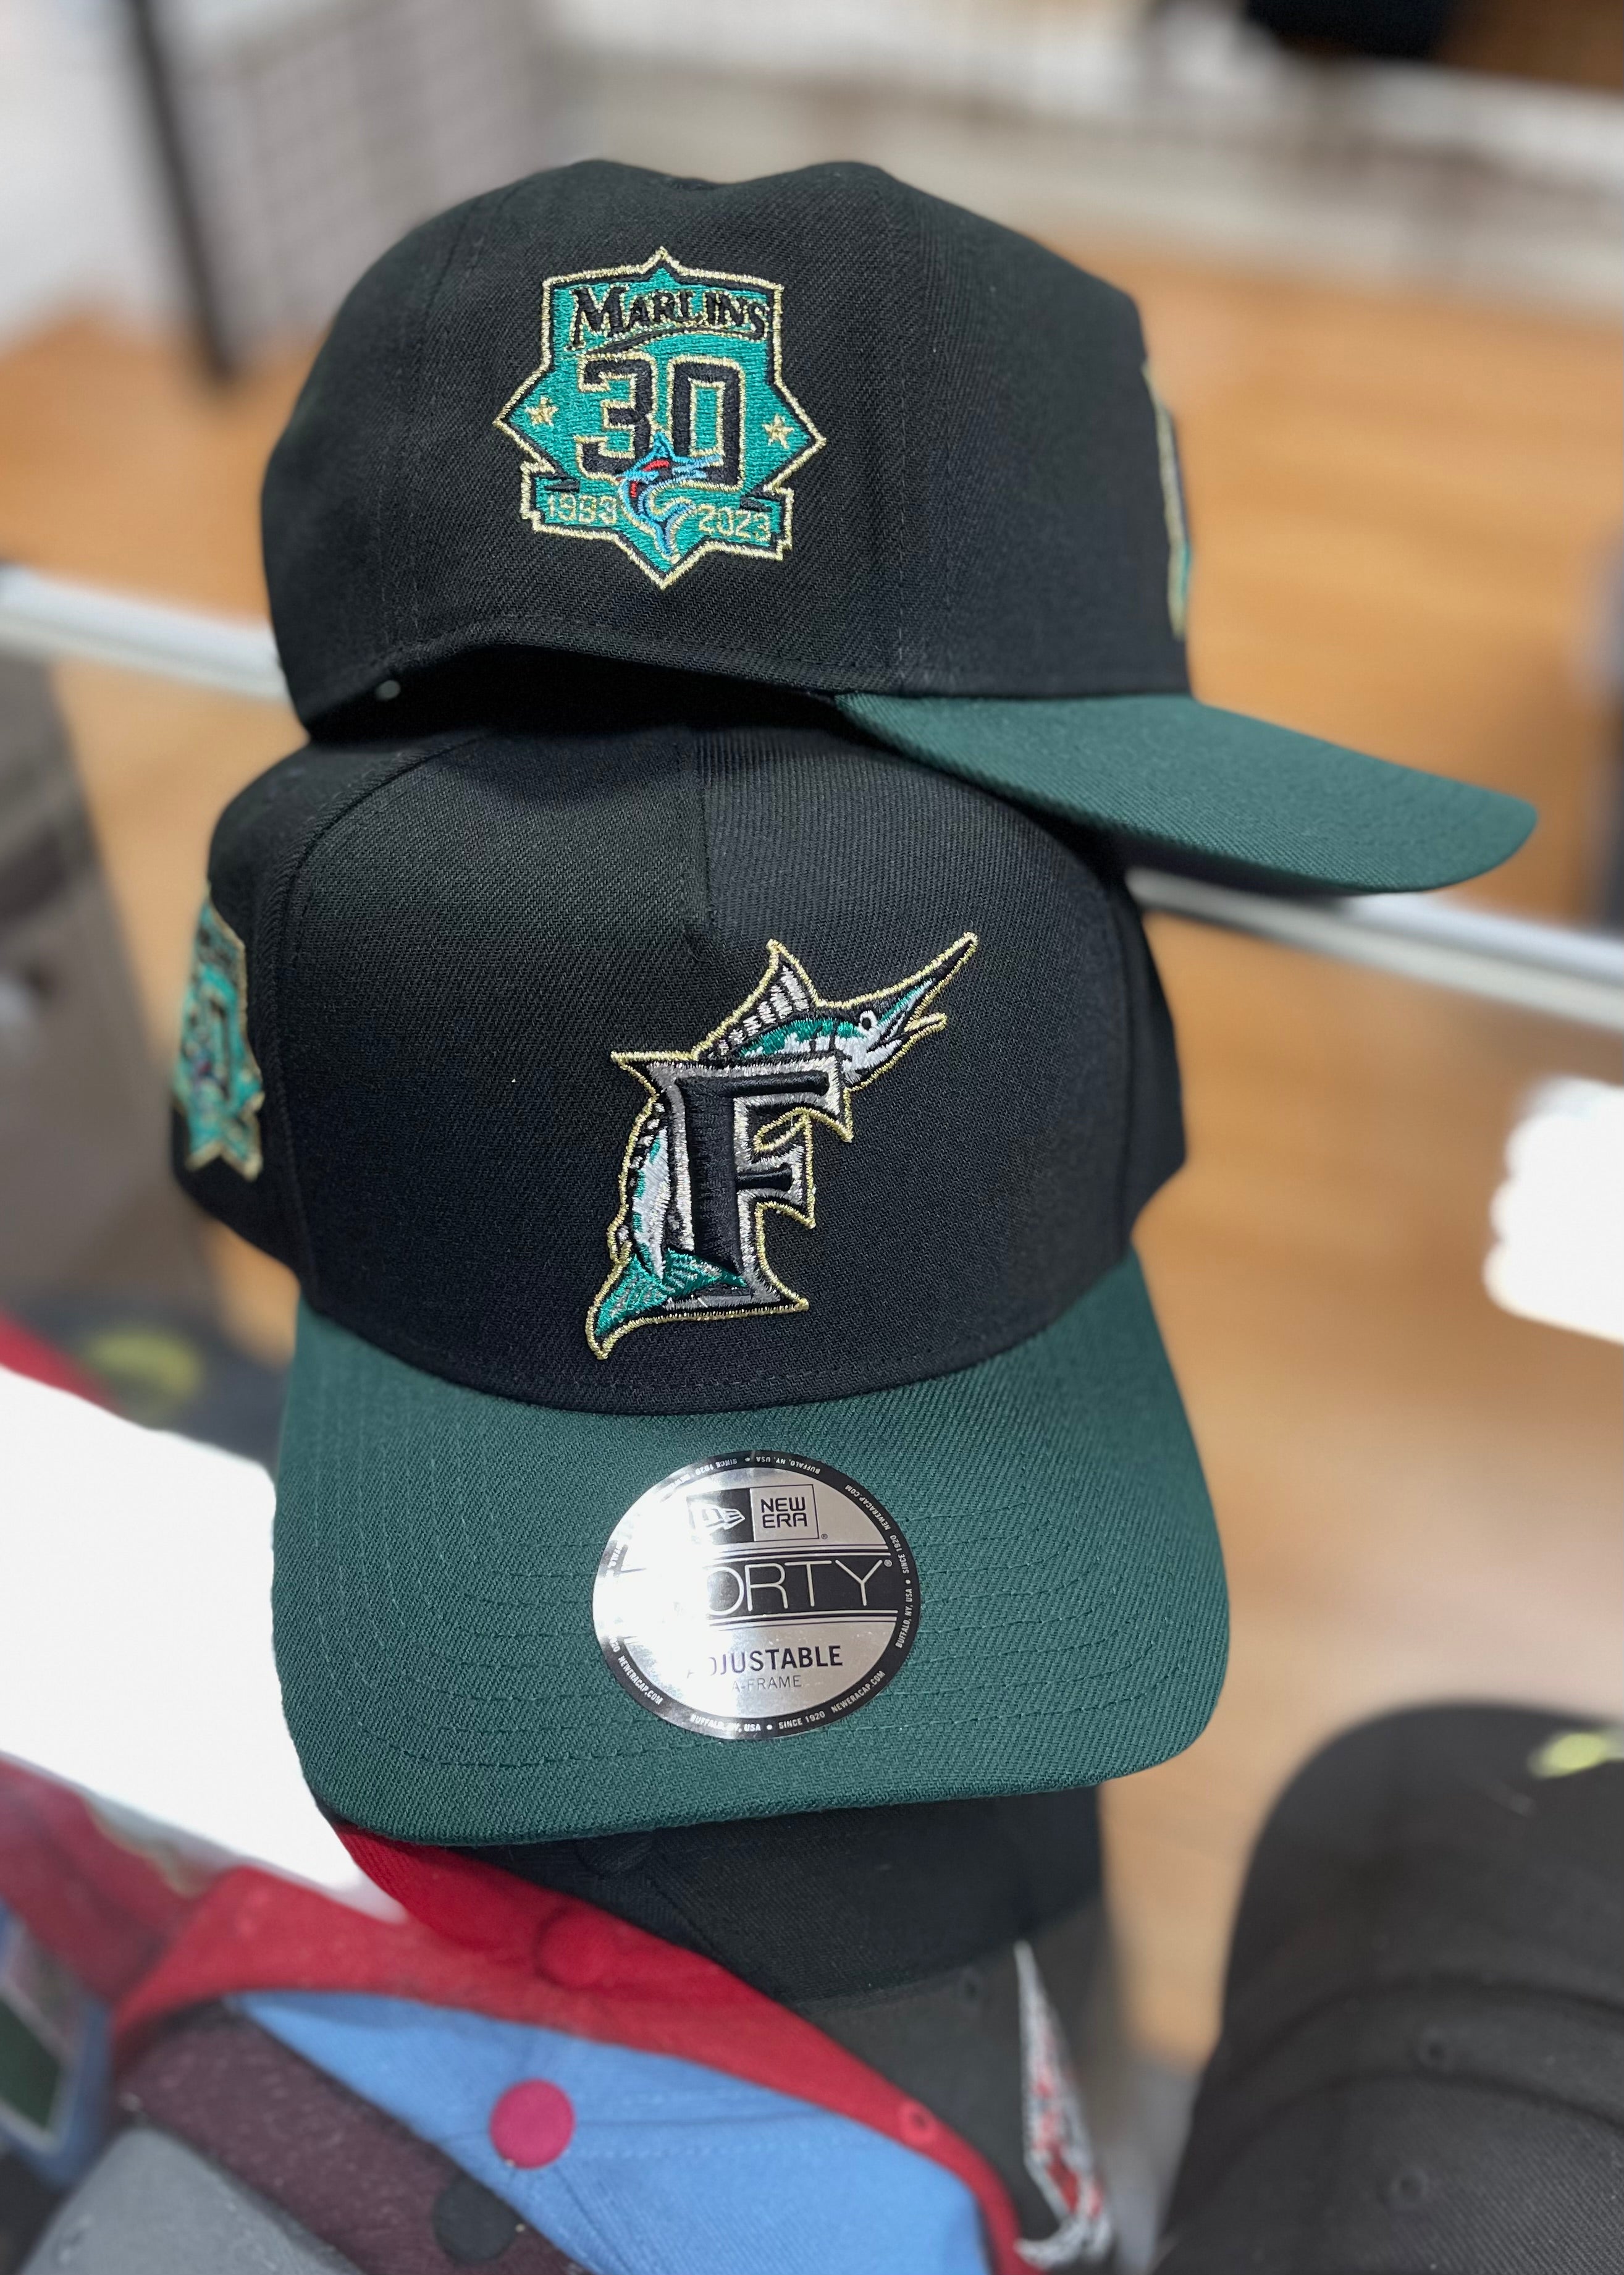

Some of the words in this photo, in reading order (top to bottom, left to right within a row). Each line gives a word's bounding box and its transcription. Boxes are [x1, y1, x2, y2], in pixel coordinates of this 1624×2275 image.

[574, 352, 744, 492] 30
[697, 504, 771, 542] 2023
[630, 1052, 848, 1312] F
[695, 1464, 714, 1475] 1920
[716, 1458, 738, 1468] SINCE
[789, 1459, 821, 1475] BUFFALO,
[760, 1496, 806, 1513] NEW
[844, 1484, 891, 1530] NEWERACAP.COM
[762, 1513, 808, 1529] ERA
[890, 1535, 902, 1552] 1920
[898, 1553, 910, 1574] SINCE
[905, 1588, 913, 1603] USA
[895, 1618, 912, 1648] BUFFALO,
[687, 1645, 843, 1678] JUSTABLE
[618, 1655, 663, 1705] NEWERACAP.COM
[731, 1674, 802, 1692] A-FRAME
[743, 1723, 761, 1732] USA
[778, 1717, 802, 1730] SINCE
[804, 1710, 826, 1724] 1920
[830, 1670, 886, 1713] NEWERACAP.COM
